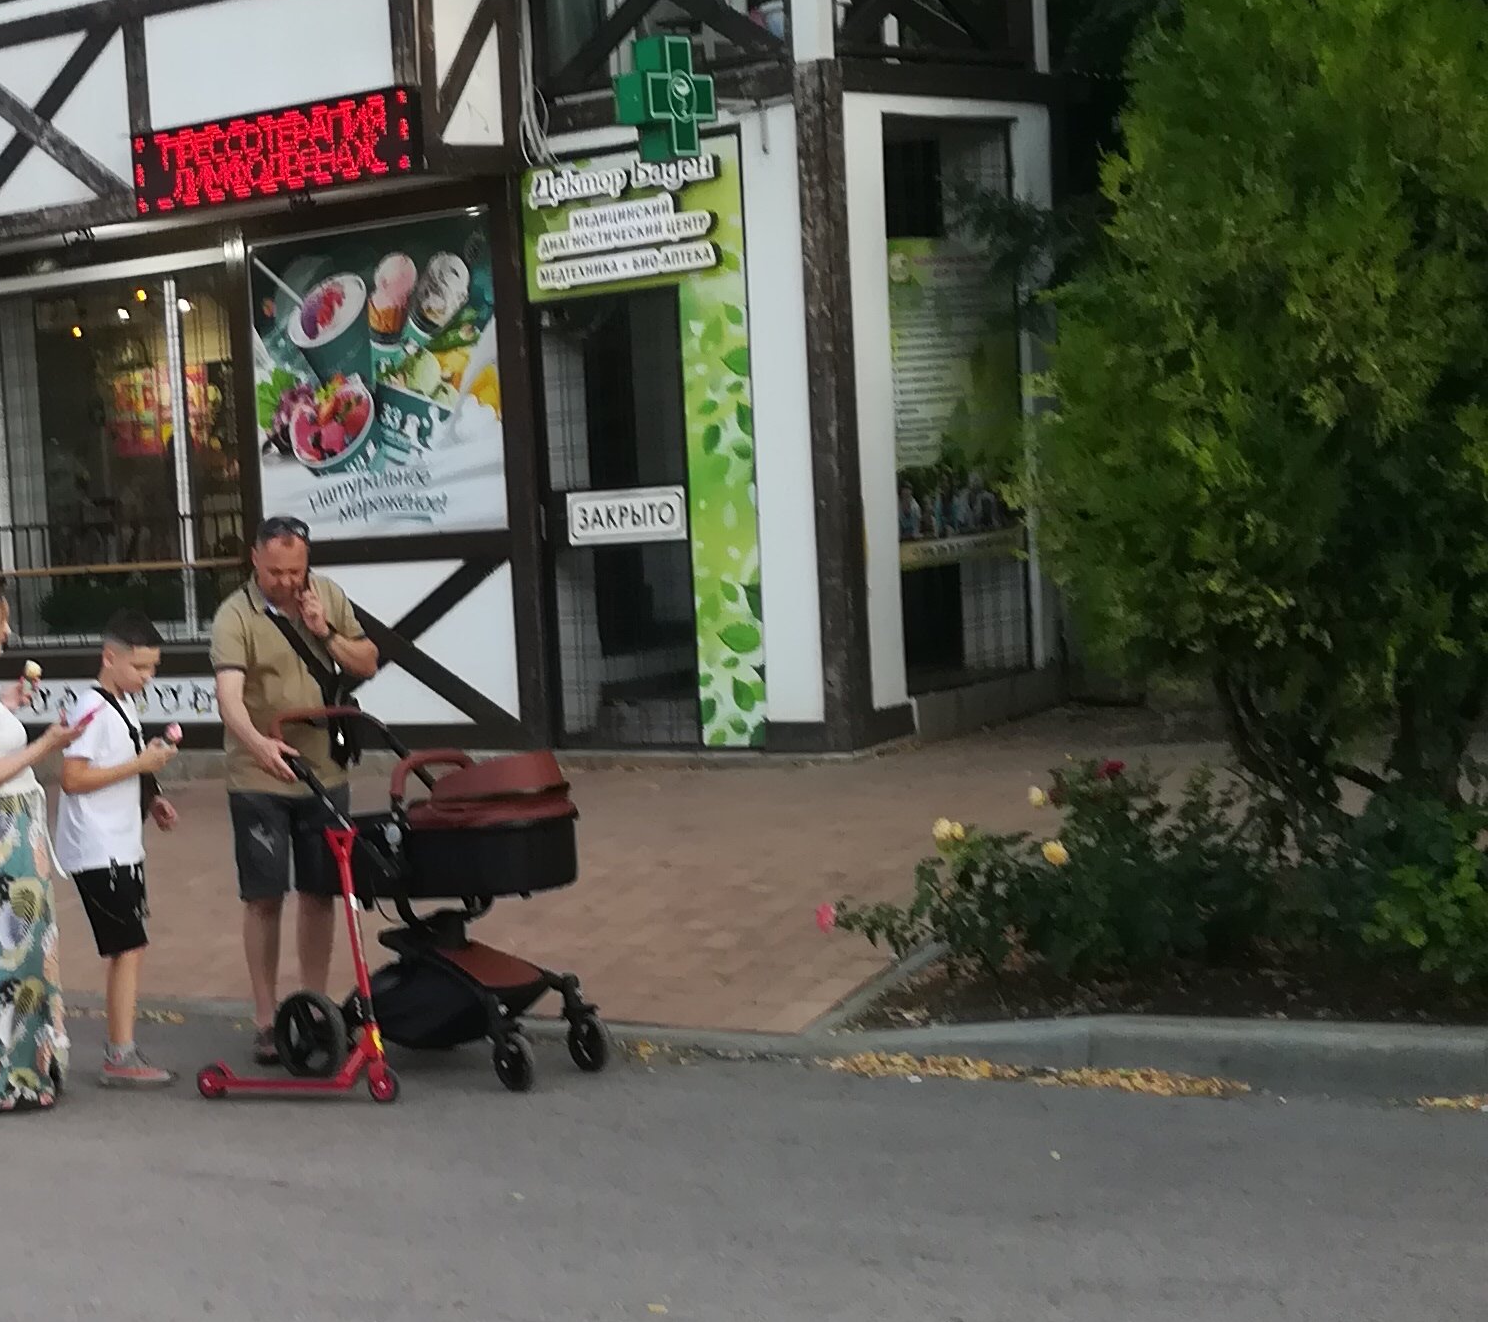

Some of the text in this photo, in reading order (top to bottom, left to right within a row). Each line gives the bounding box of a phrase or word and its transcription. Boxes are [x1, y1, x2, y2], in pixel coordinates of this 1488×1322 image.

[529, 169, 627, 210] Доктор
[572, 197, 671, 228] МЕДИЦИНСКИЙ
[540, 214, 710, 255] ДИАГНОСТИЧЕСКИЙ ЦЕНТР
[539, 261, 619, 287] МЕДТЕХНИКА
[577, 500, 676, 531] ЗАКРЫТО
